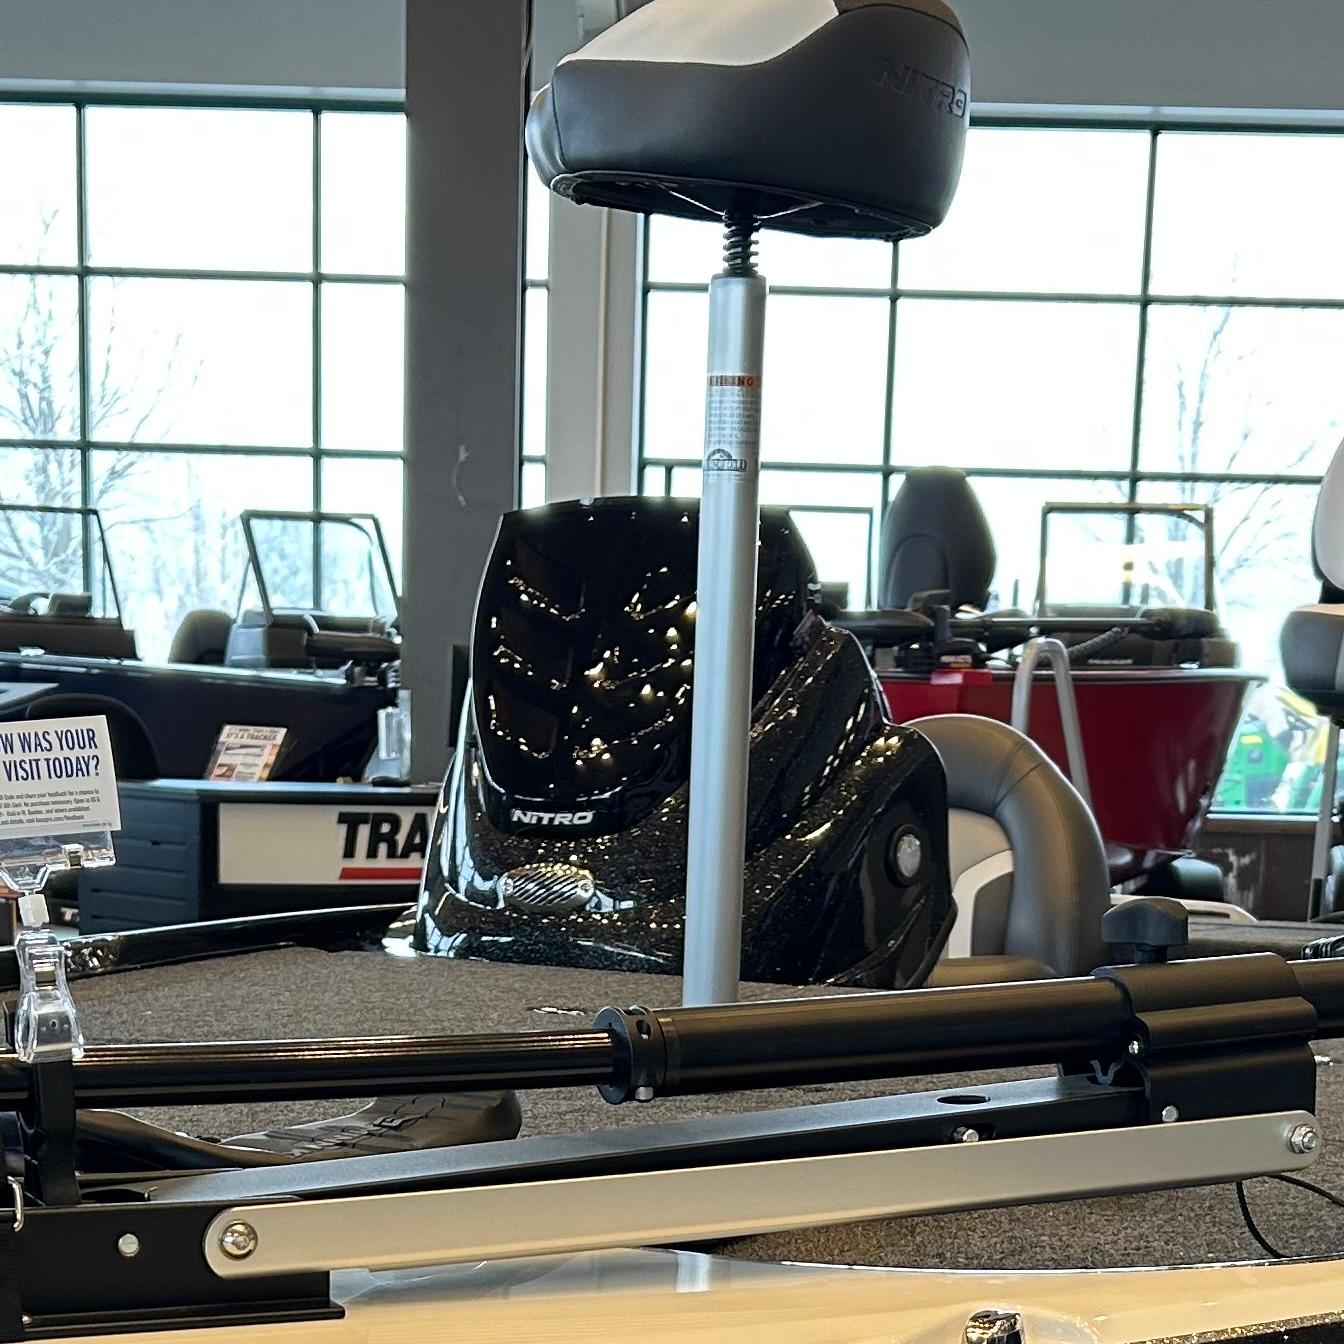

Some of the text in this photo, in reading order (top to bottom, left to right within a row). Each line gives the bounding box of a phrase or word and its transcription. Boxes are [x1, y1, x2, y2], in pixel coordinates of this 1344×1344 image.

[18, 730, 53, 754] WAS
[56, 728, 99, 750] YOUR
[3, 754, 100, 782] VISIT TODAY?
[512, 808, 595, 826] NITRO
